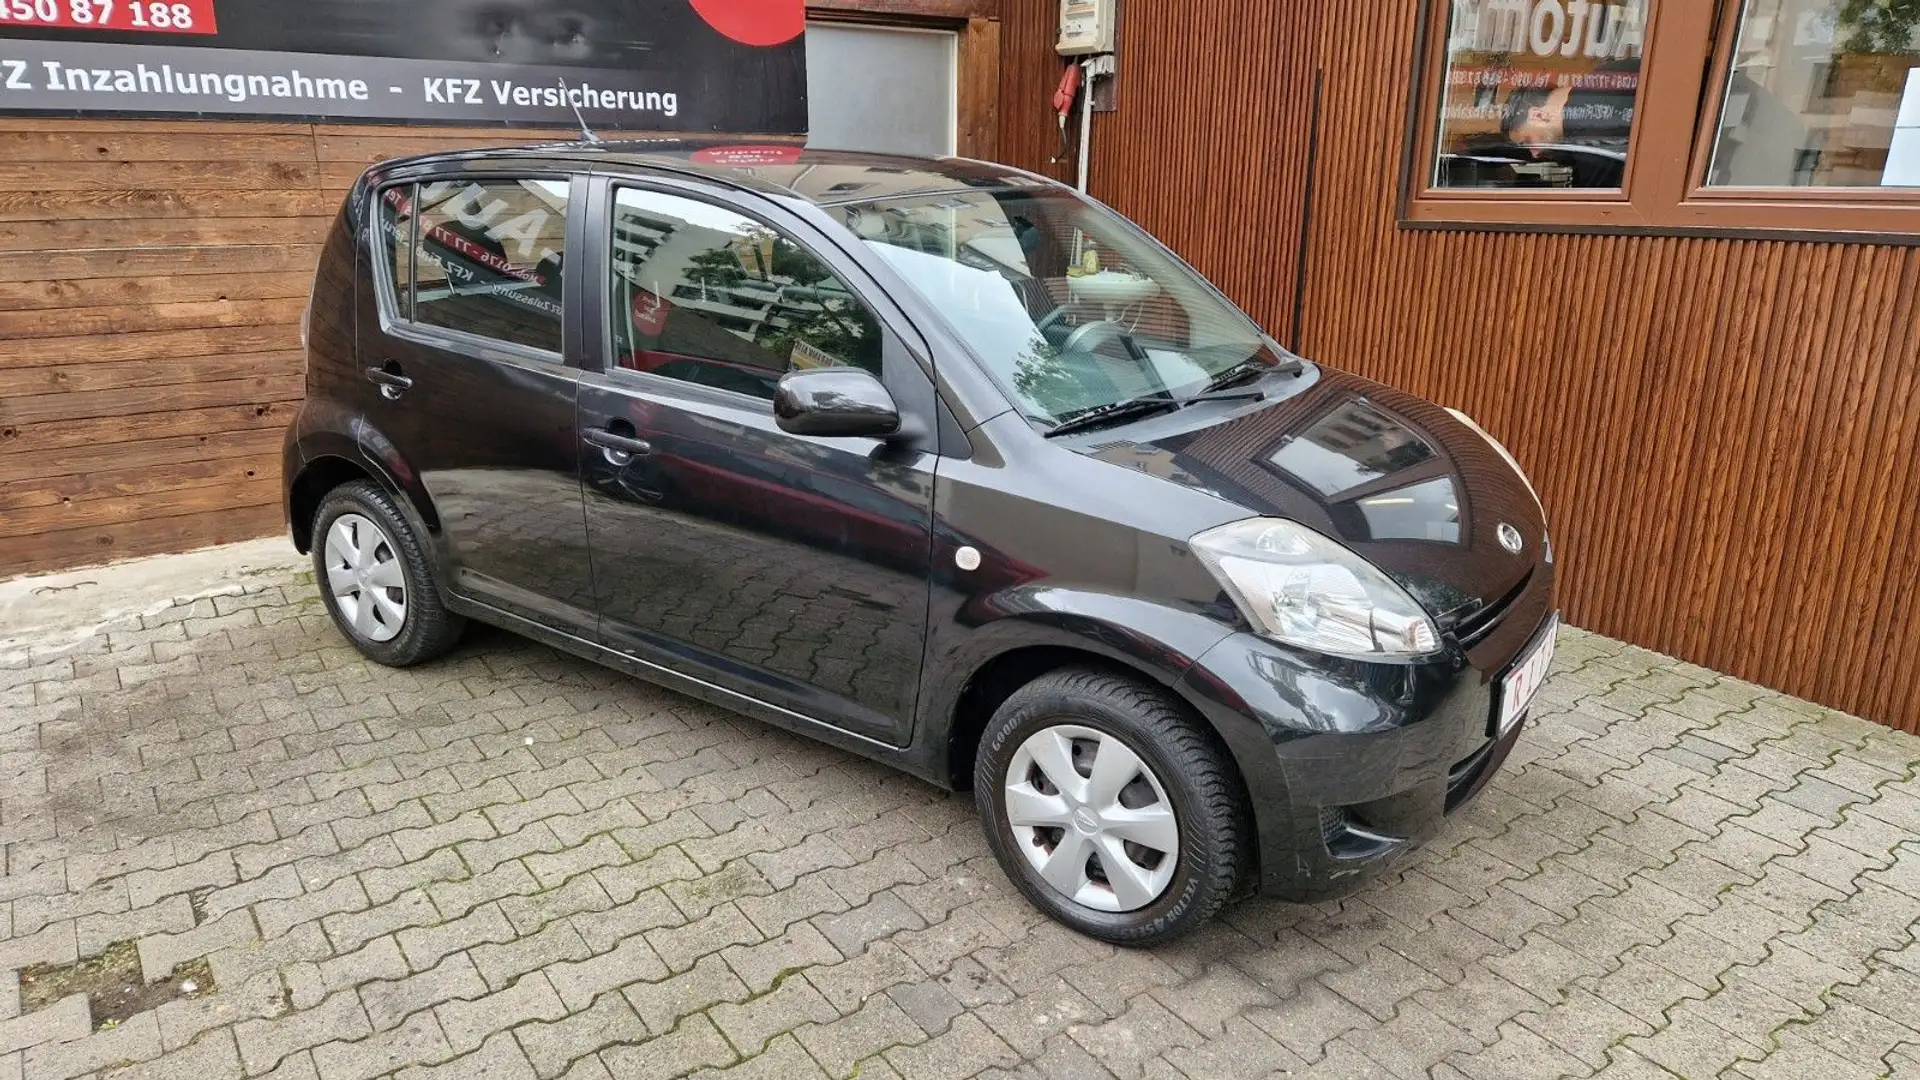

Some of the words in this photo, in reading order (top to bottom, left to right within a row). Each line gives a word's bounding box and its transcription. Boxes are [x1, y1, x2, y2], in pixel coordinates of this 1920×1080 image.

[70, 0, 114, 25] 87
[128, 2, 193, 29] 188
[0, 60, 32, 90] Z
[42, 60, 369, 102] Inzahlungnahme
[423, 77, 483, 105] KFZ
[490, 79, 678, 117] Versicherung
